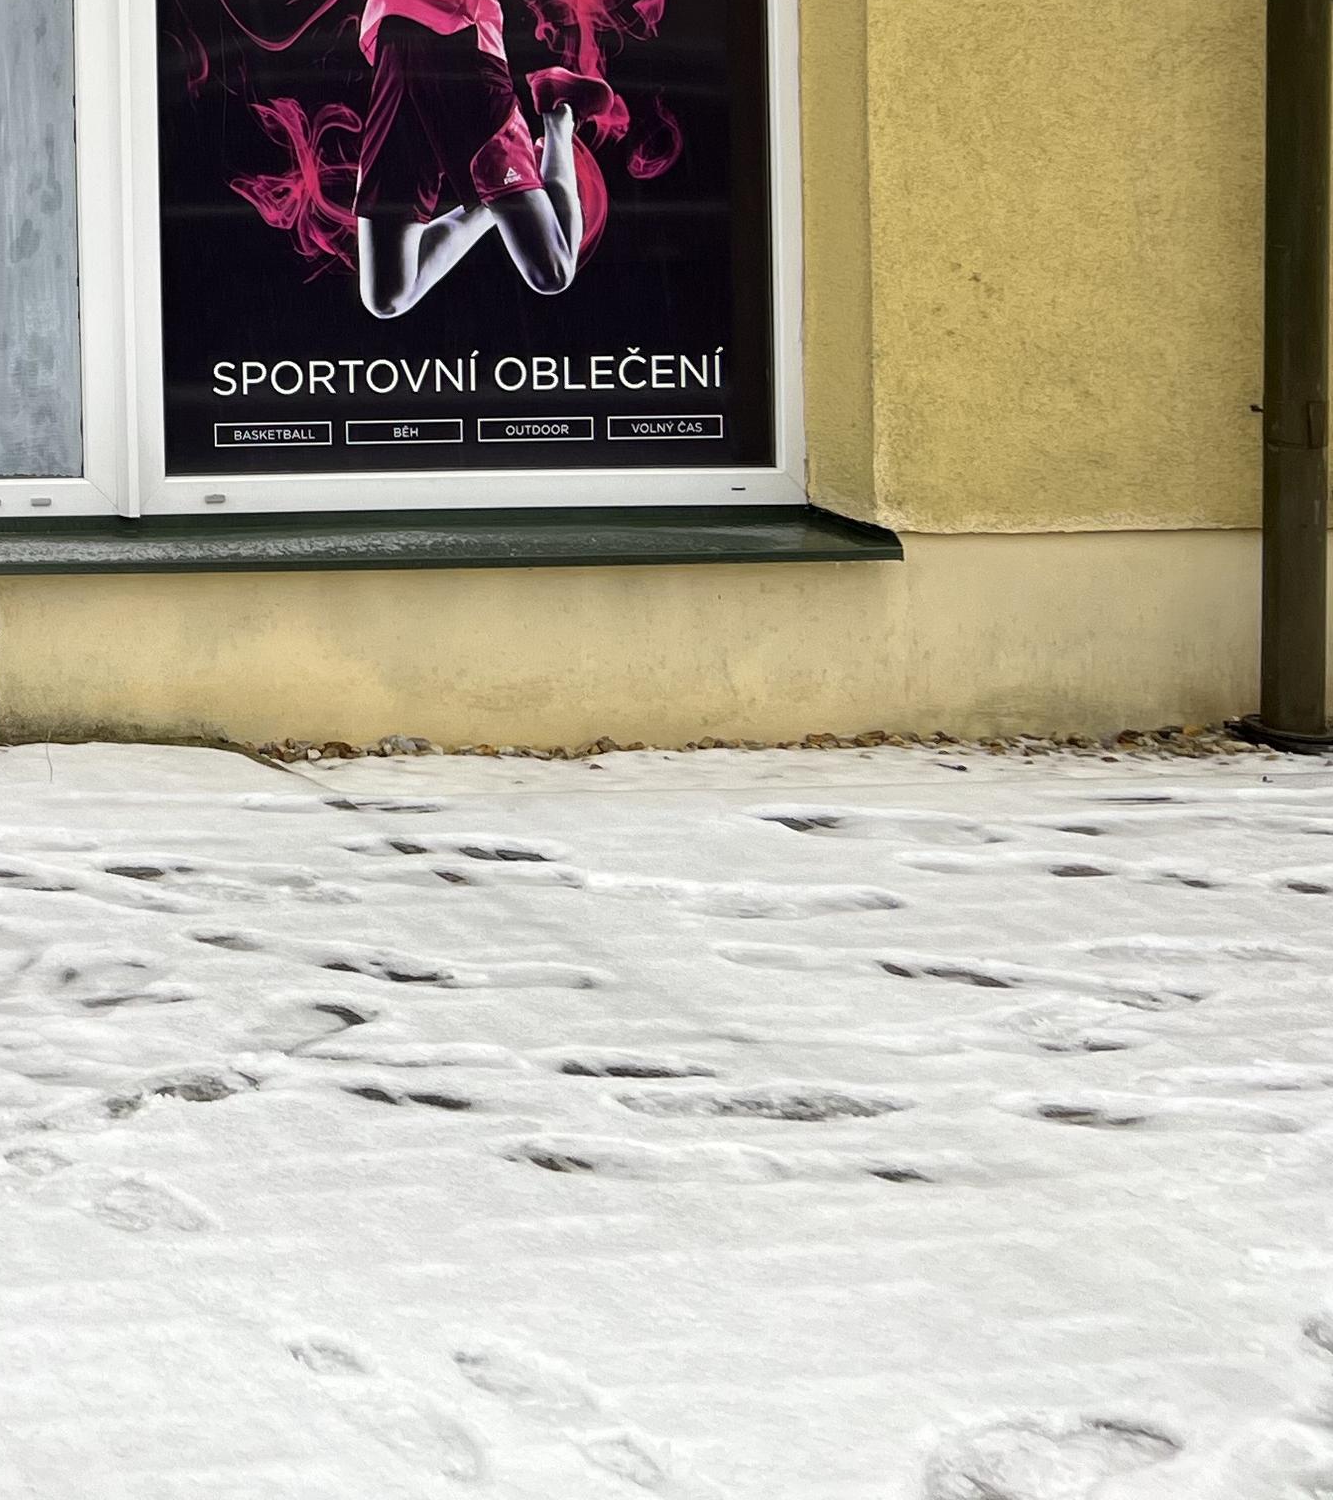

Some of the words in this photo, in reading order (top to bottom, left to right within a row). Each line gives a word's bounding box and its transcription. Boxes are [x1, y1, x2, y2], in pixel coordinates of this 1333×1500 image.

[212, 349, 480, 396] SPORTOVNÍ
[494, 346, 724, 392] OBLEČENÍ
[392, 425, 420, 439] BĚH
[505, 423, 570, 437] OUTDOOR
[630, 420, 674, 435] VOLNÝ
[675, 418, 703, 434] ČAS
[233, 428, 316, 442] BASKETBALL
